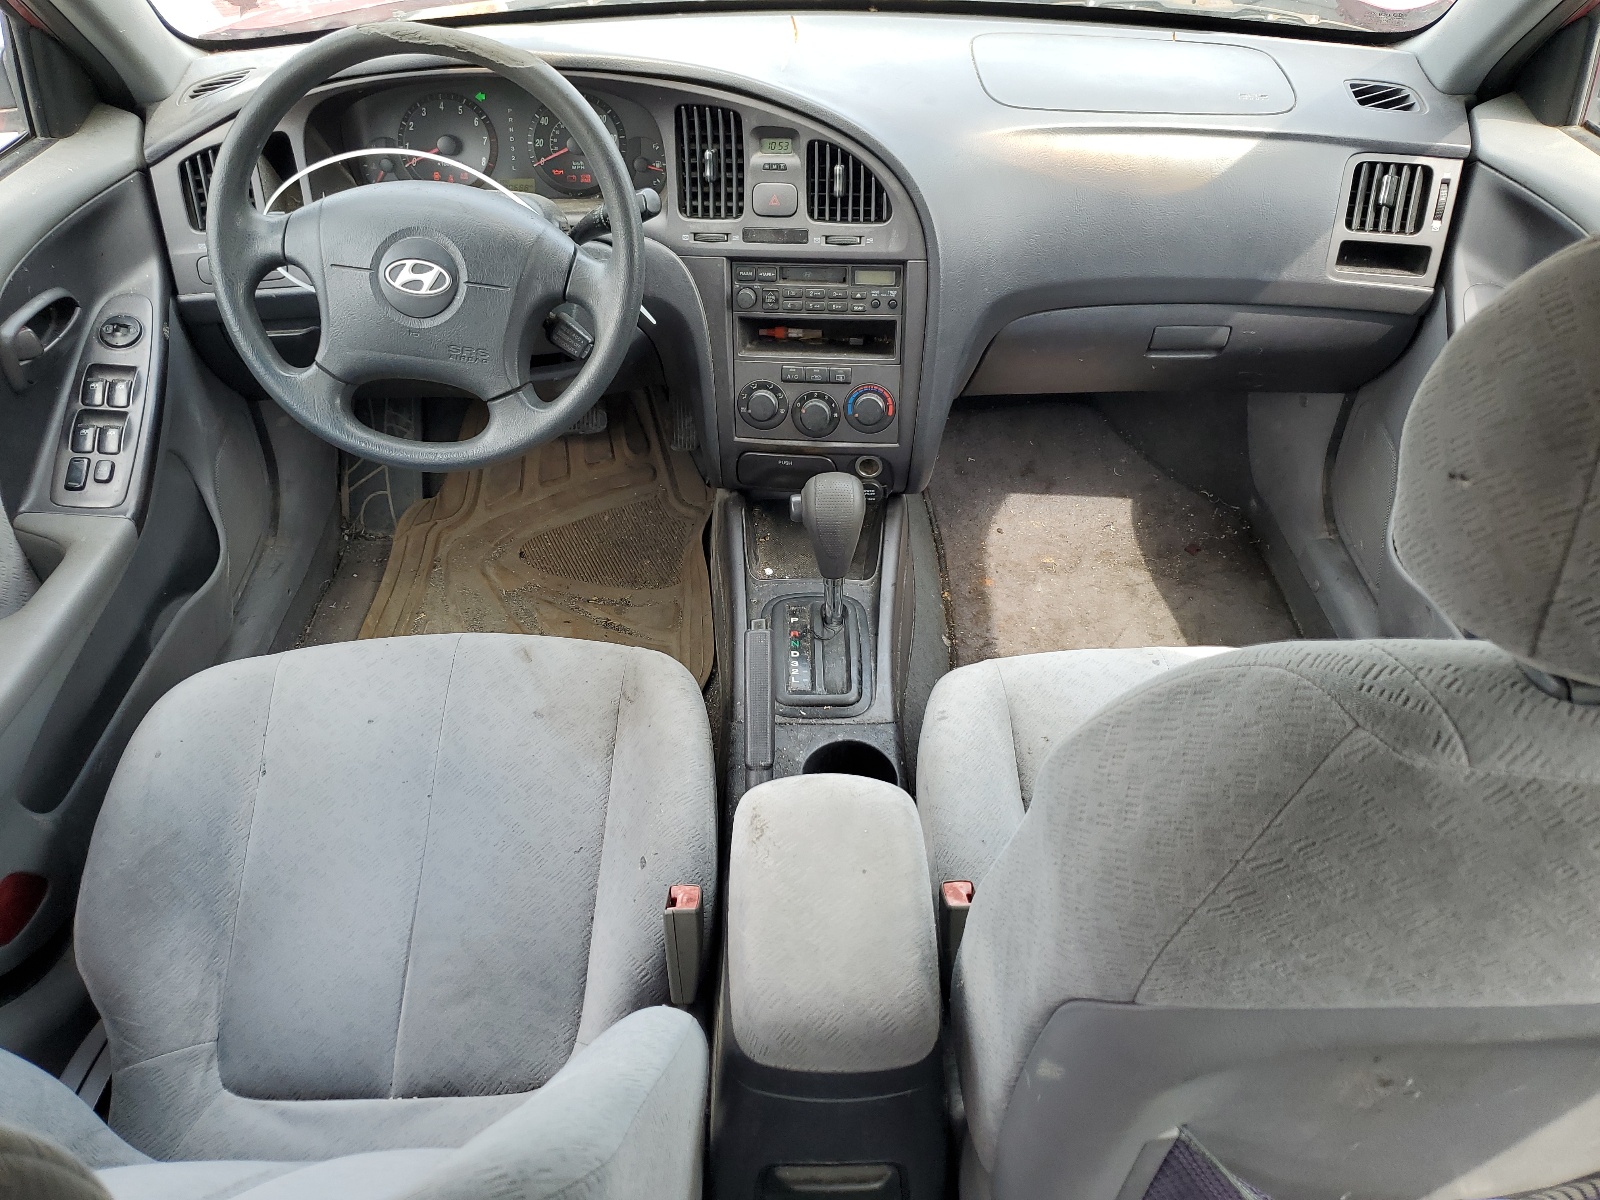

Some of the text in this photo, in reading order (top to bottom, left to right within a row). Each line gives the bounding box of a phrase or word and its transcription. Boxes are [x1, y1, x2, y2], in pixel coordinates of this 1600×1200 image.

[421, 107, 427, 117] 3
[539, 116, 549, 126] 40
[408, 122, 414, 131] 2
[535, 138, 544, 147] 20
[791, 640, 800, 648] N
